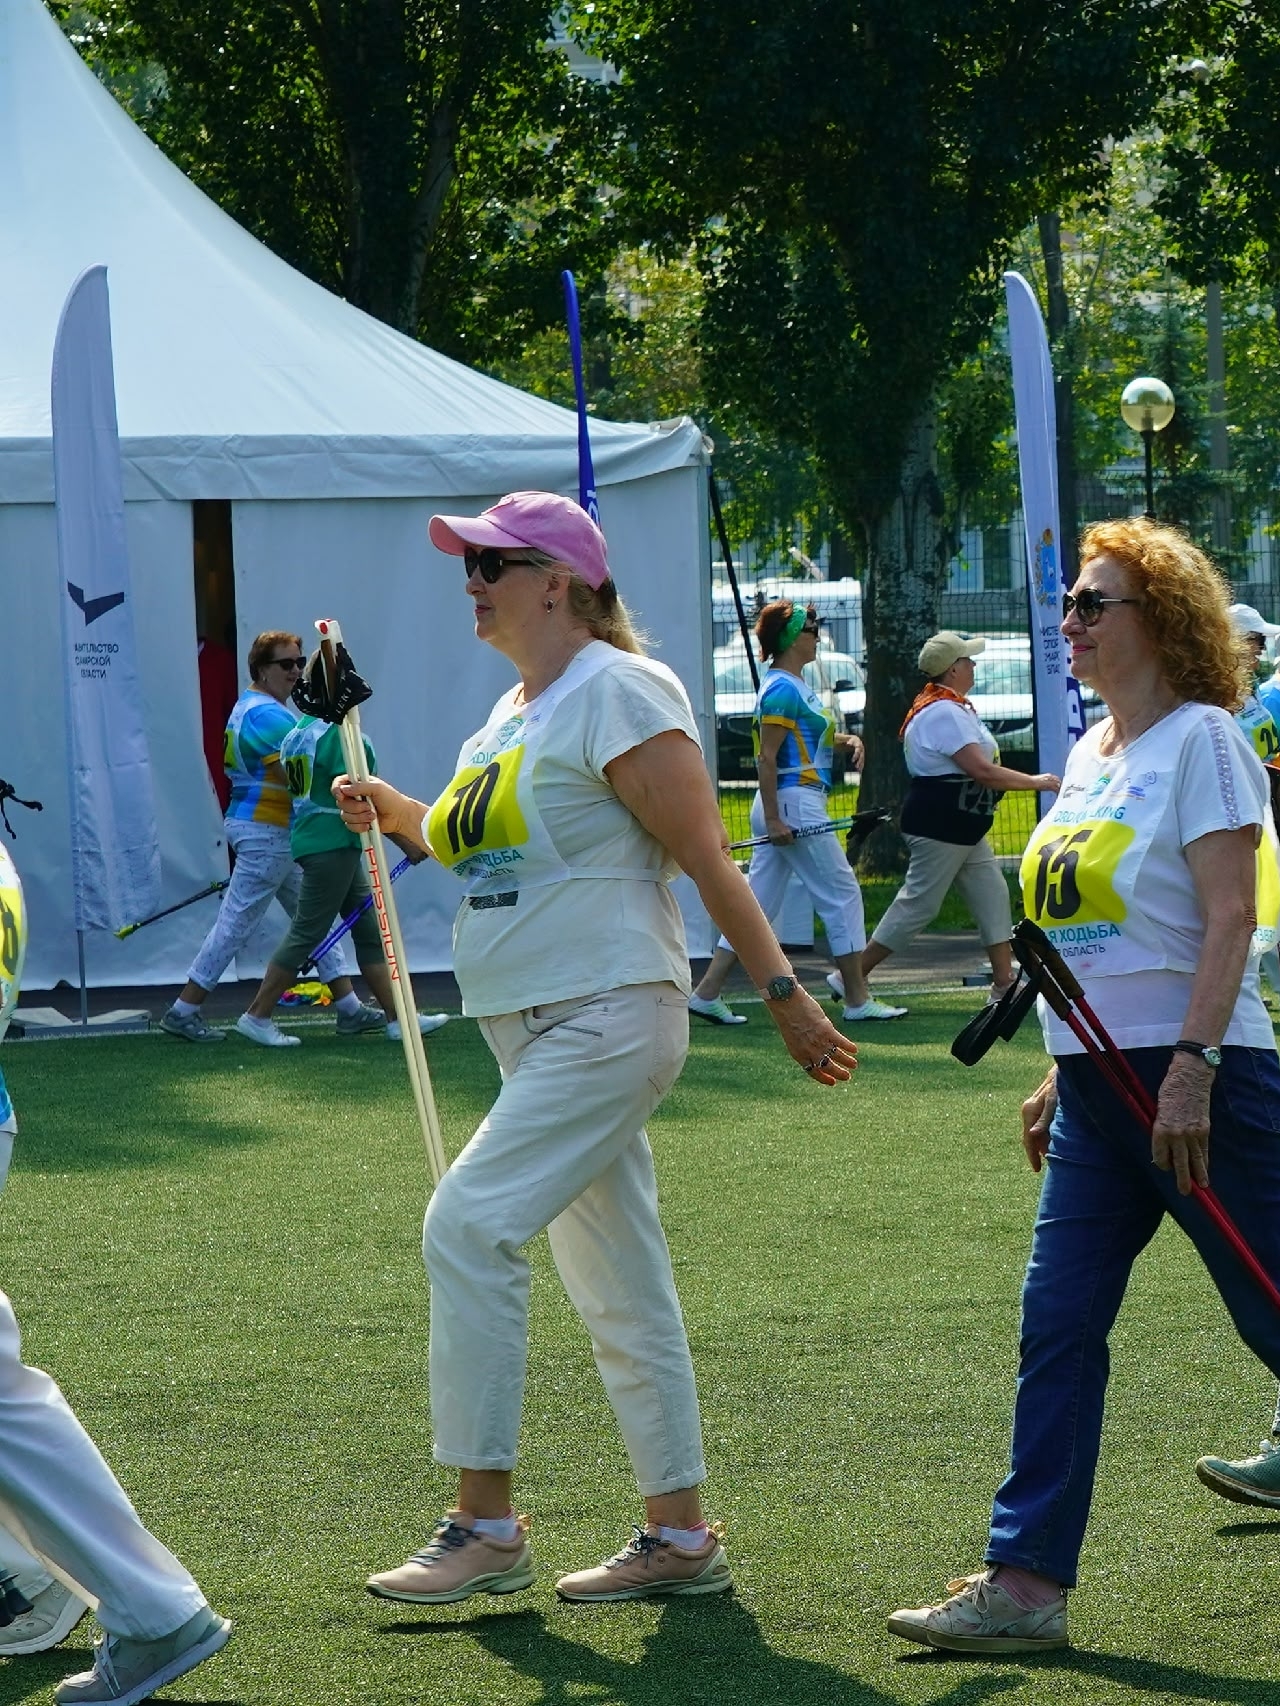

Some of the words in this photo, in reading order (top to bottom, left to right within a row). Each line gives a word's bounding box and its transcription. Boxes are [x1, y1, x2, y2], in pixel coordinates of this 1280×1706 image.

[446, 762, 500, 855] 10
[364, 845, 401, 981] PASSION
[1036, 829, 1094, 922] 15
[1059, 923, 1122, 943] ХОДЬБА
[1062, 944, 1106, 958] ОБЛАСТЬ
